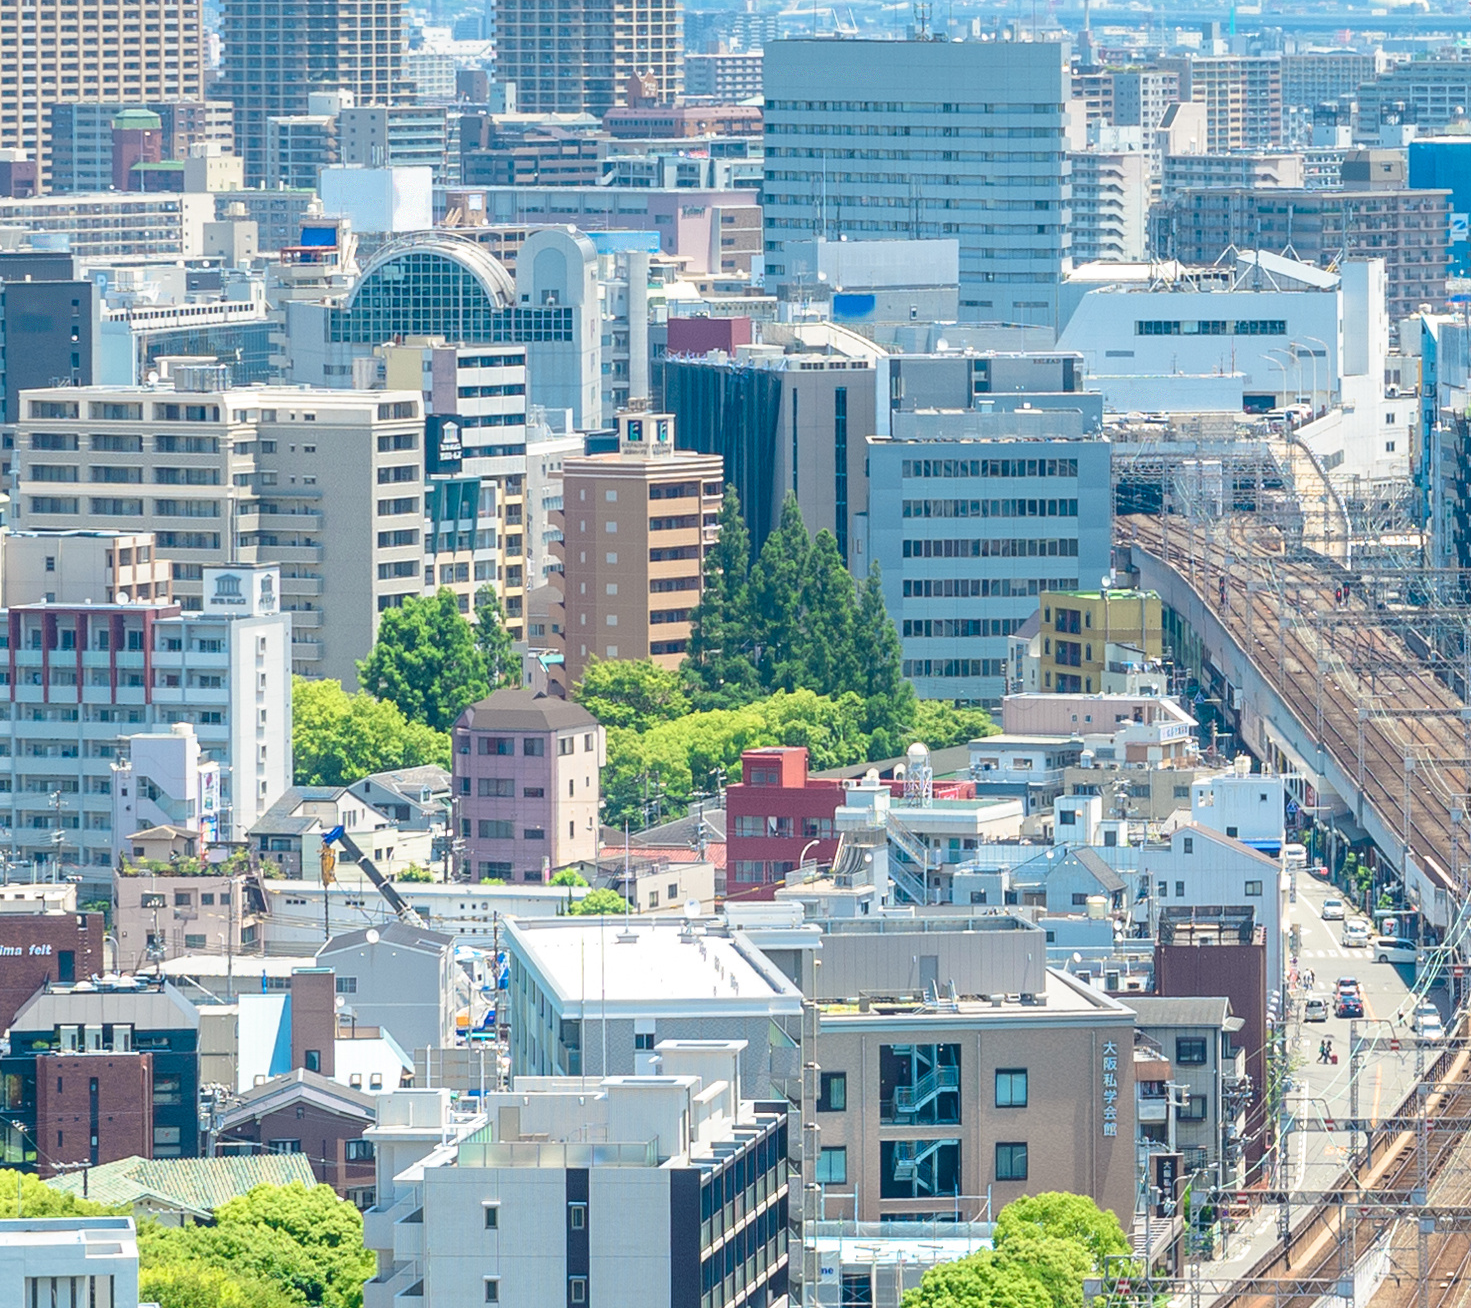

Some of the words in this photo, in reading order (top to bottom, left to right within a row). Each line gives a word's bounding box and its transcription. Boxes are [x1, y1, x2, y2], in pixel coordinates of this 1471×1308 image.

[29, 944, 52, 956] felt
[1103, 1040, 1118, 1137] 大阪私学会館
